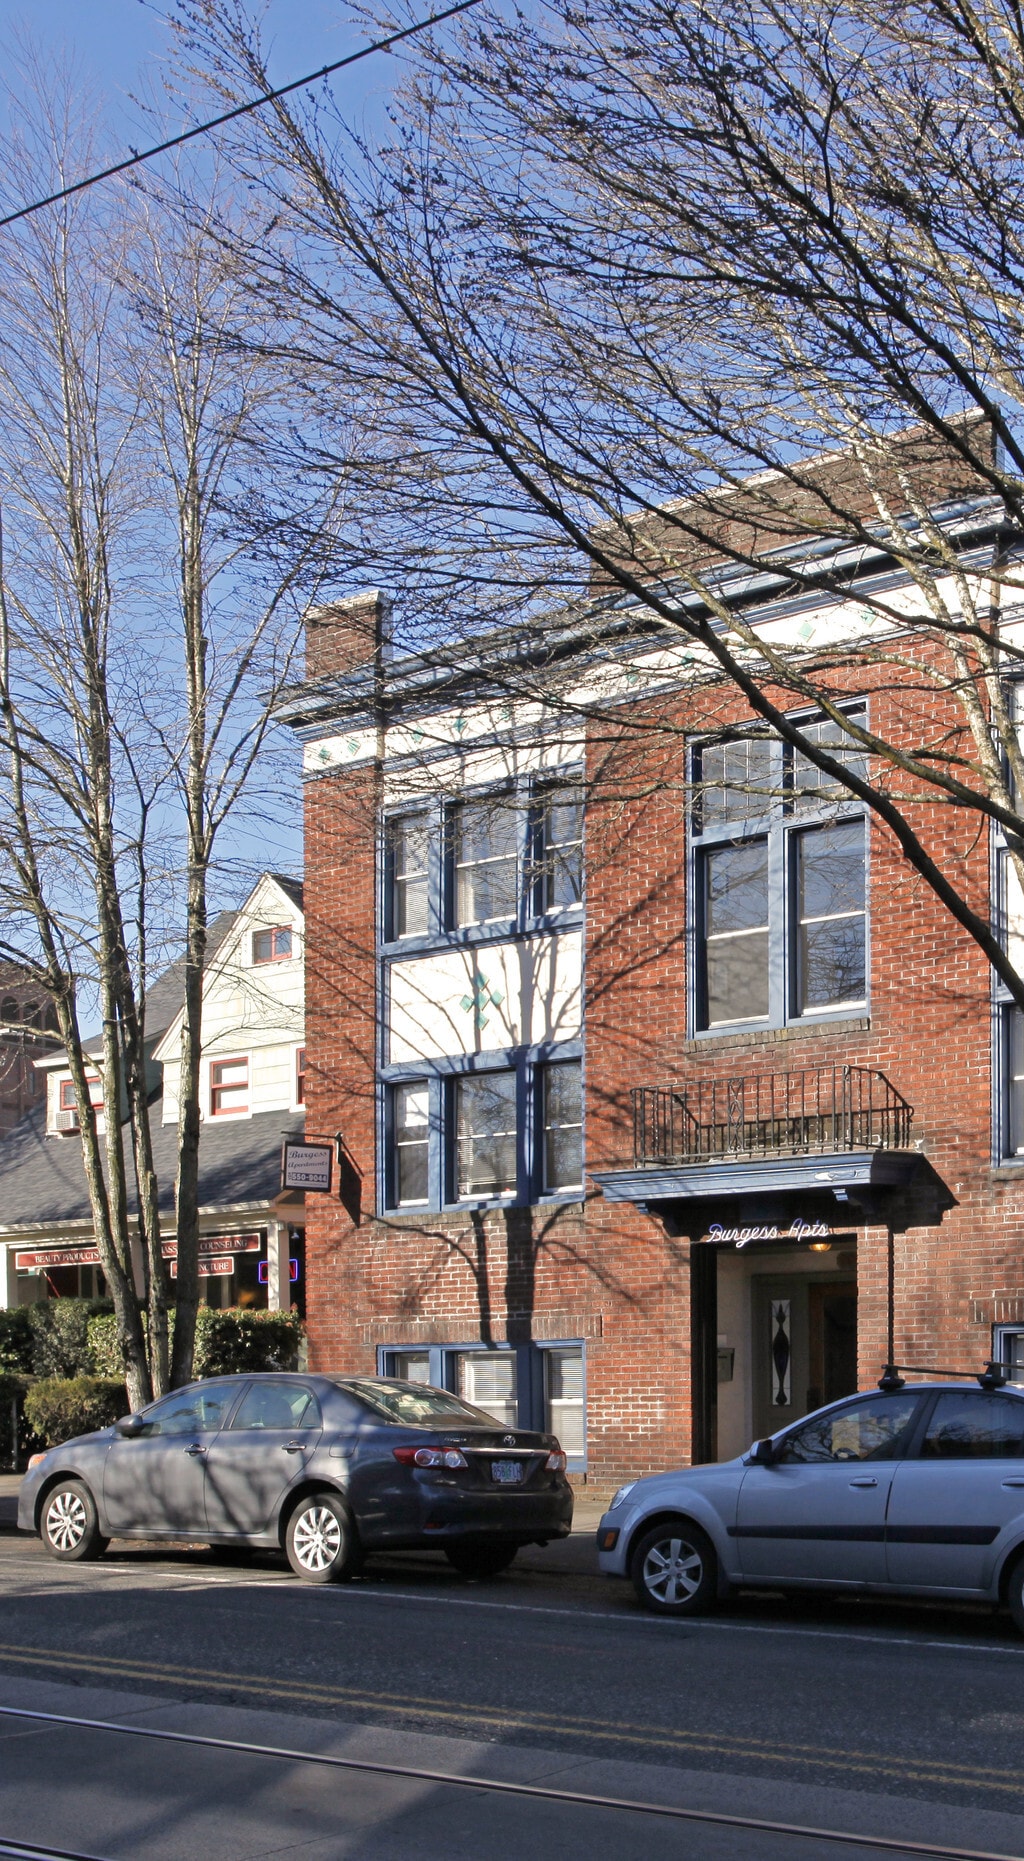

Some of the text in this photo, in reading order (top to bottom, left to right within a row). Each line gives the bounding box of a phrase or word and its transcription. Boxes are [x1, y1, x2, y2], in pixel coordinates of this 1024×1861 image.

[289, 1151, 327, 1159] Burgess
[706, 1217, 829, 1248] Burgess Apts
[200, 1239, 247, 1250] COUNSELING
[35, 1251, 99, 1263] BEAUTY PRODUCTS
